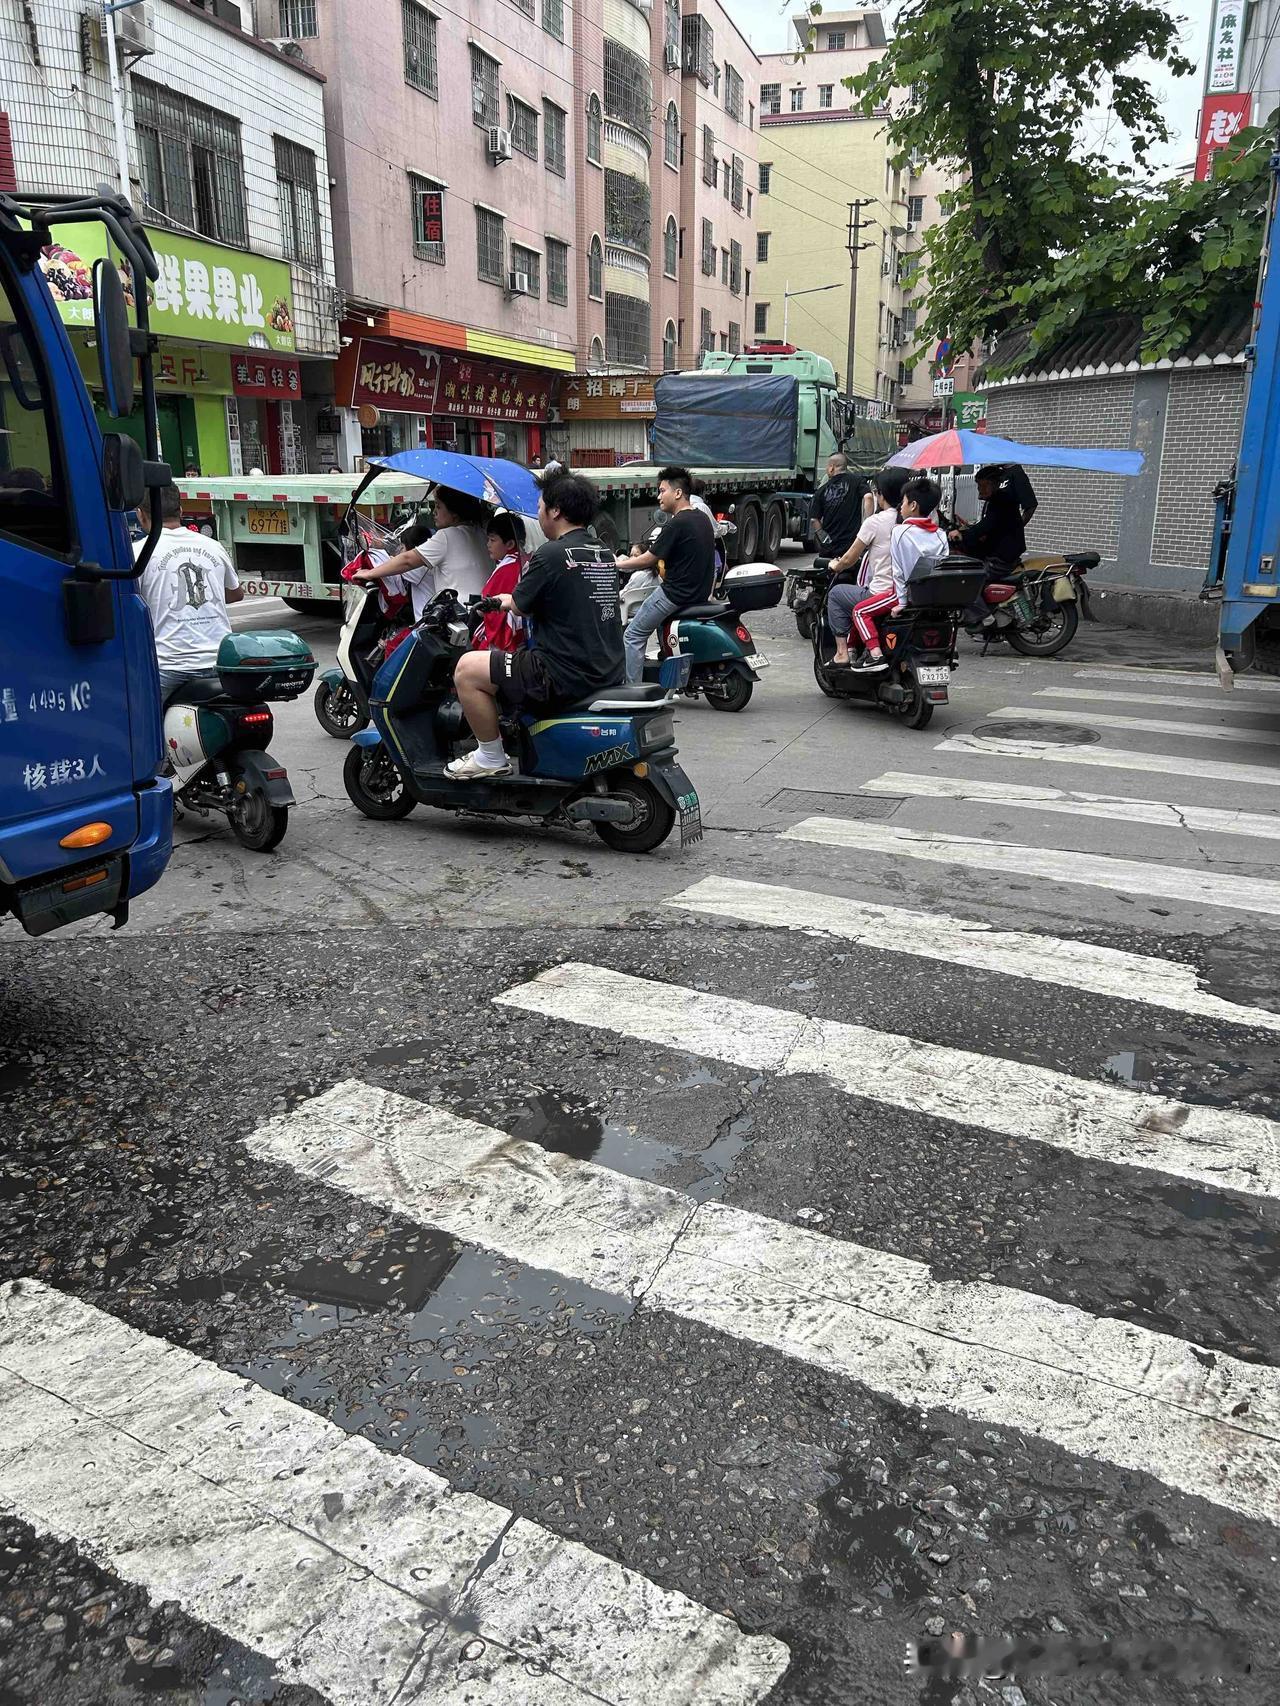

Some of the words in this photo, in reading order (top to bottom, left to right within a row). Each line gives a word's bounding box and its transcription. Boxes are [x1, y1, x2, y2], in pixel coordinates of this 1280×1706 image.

[1217, 14, 1237, 62] 麻友社
[1205, 110, 1243, 144] 赵
[424, 195, 441, 240] 住宿
[153, 251, 265, 328] 鲜果果业
[360, 361, 416, 397] 风行牛奶
[567, 379, 582, 411] 大朗
[586, 378, 650, 397] 招牌厂
[961, 401, 985, 424] 药
[251, 518, 287, 533] 6977挂
[2, 688, 18, 721] 量
[29, 689, 66, 712] 4495
[70, 681, 91, 711] KG
[23, 754, 106, 791] 核载3人
